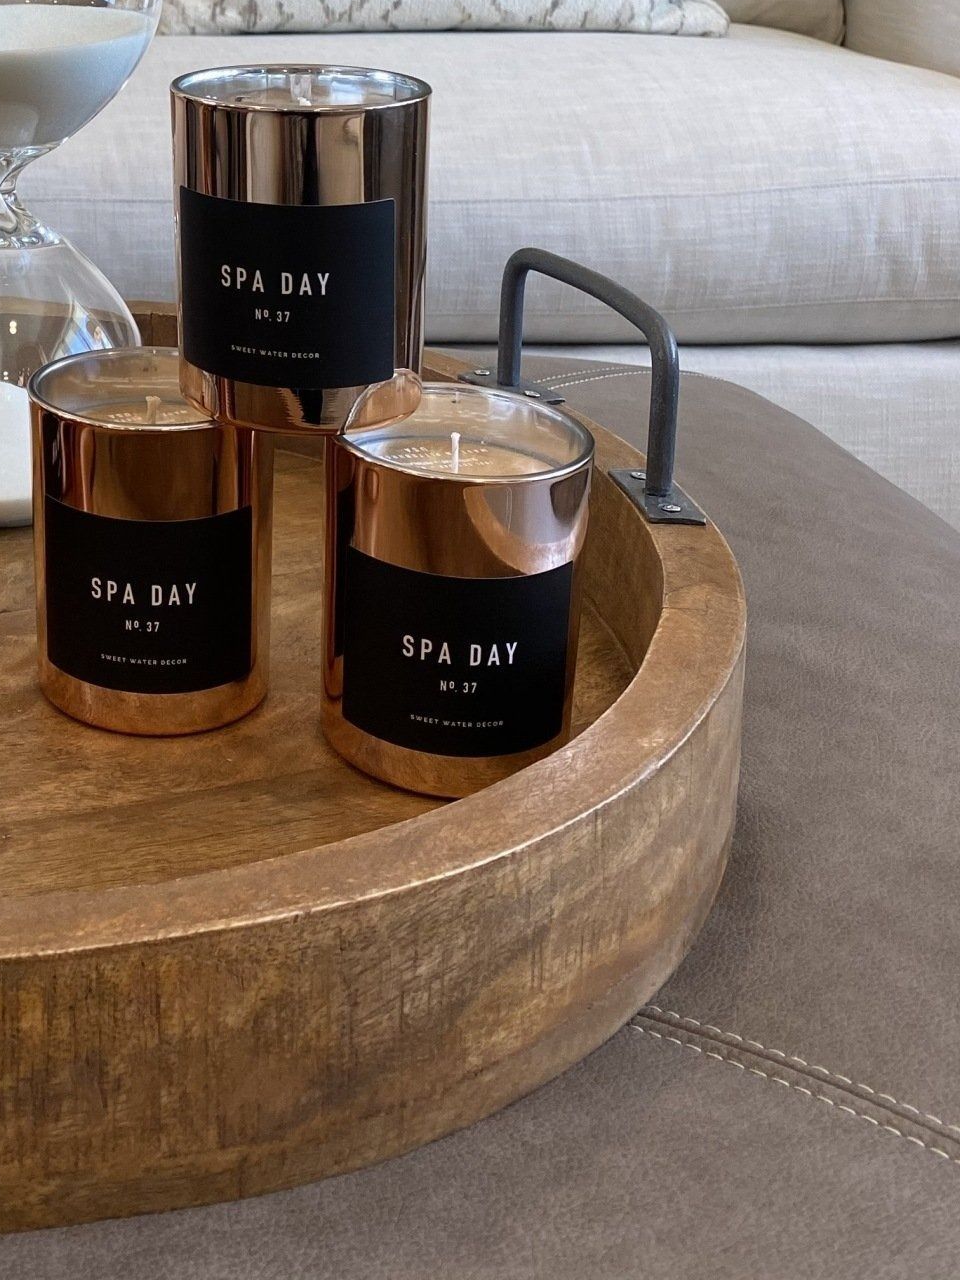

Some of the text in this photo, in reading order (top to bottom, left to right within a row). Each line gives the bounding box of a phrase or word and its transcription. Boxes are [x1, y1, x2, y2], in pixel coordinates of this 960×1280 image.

[221, 264, 330, 296] SPA DAY
[276, 310, 291, 323] 37
[231, 344, 257, 355] SWEET
[259, 349, 288, 358] WATER
[91, 577, 197, 607] SPA DAY
[146, 621, 160, 633] 37
[402, 634, 518, 667] SPA DAY
[100, 653, 187, 666] SWEET WATER DECOR
[462, 681, 478, 694] 37
[410, 714, 504, 729] SWEET WATER DECOR
